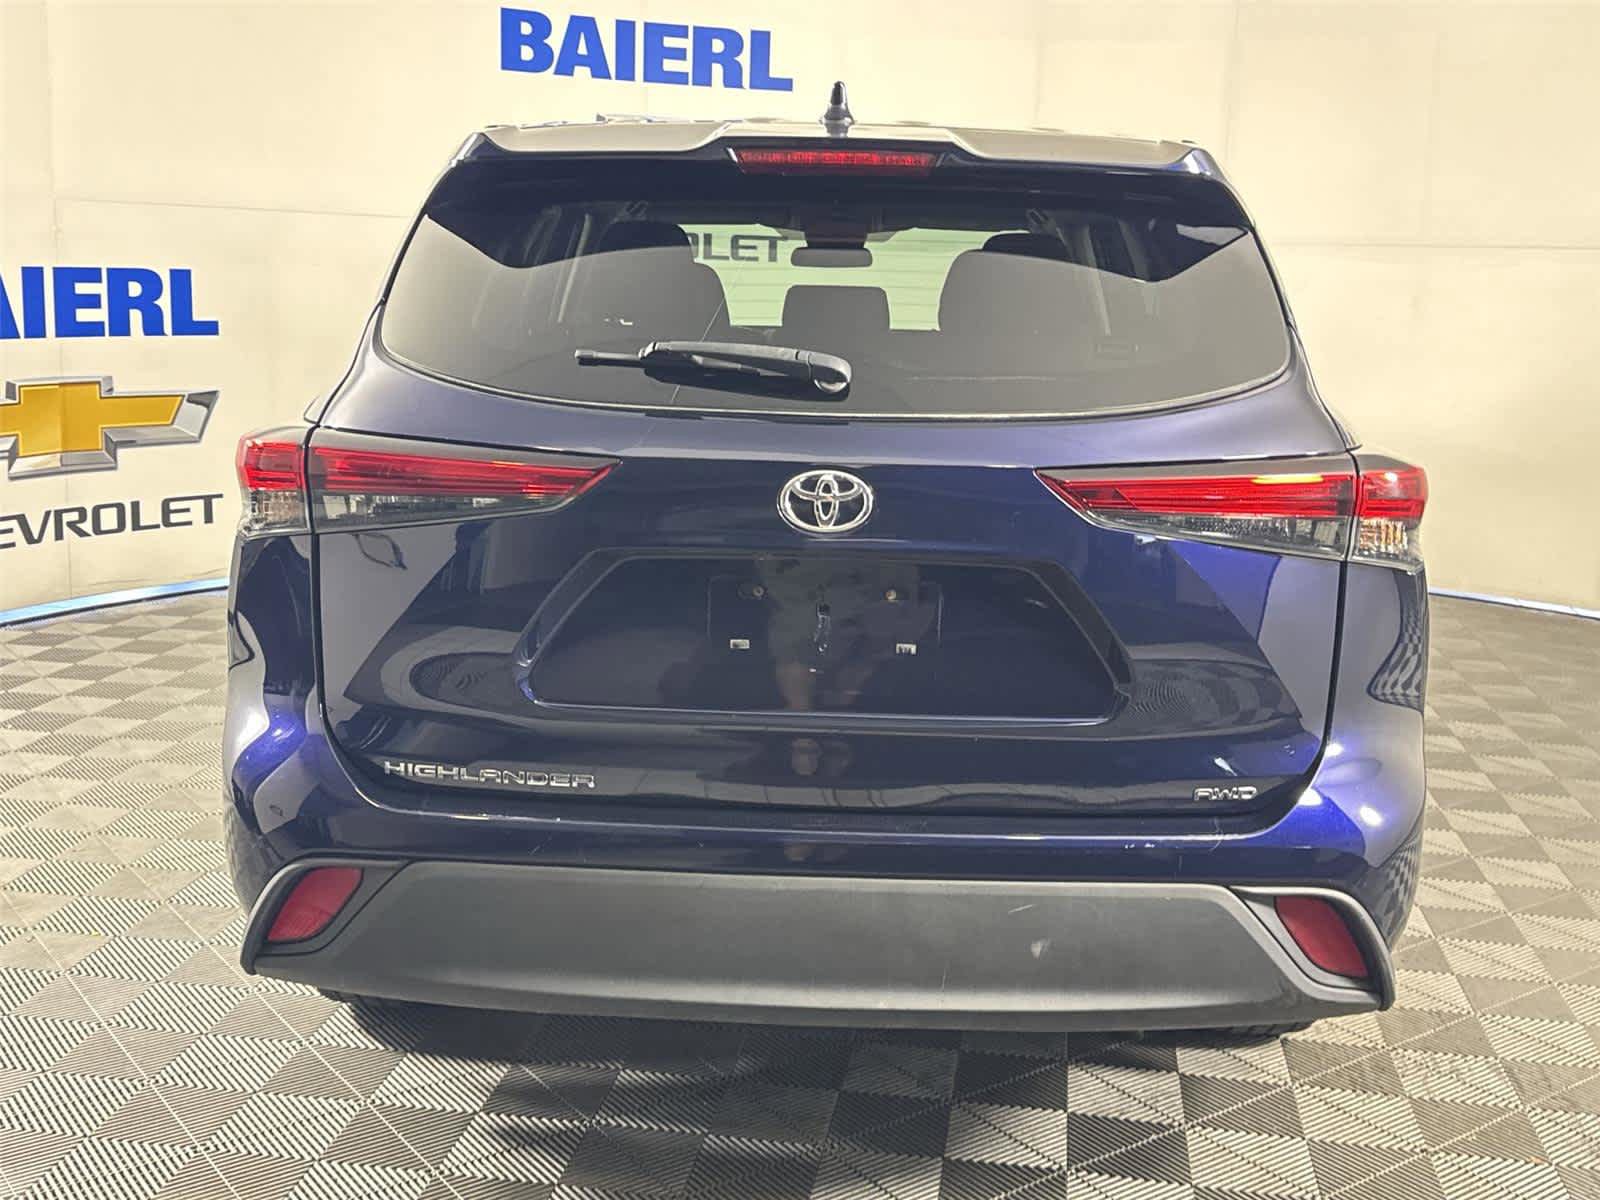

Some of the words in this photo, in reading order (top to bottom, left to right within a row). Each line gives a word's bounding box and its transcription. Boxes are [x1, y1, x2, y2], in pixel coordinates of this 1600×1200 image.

[500, 7, 793, 92] BAIERL
[383, 760, 596, 789] HIGHLANDER
[1193, 786, 1257, 801] AWD
